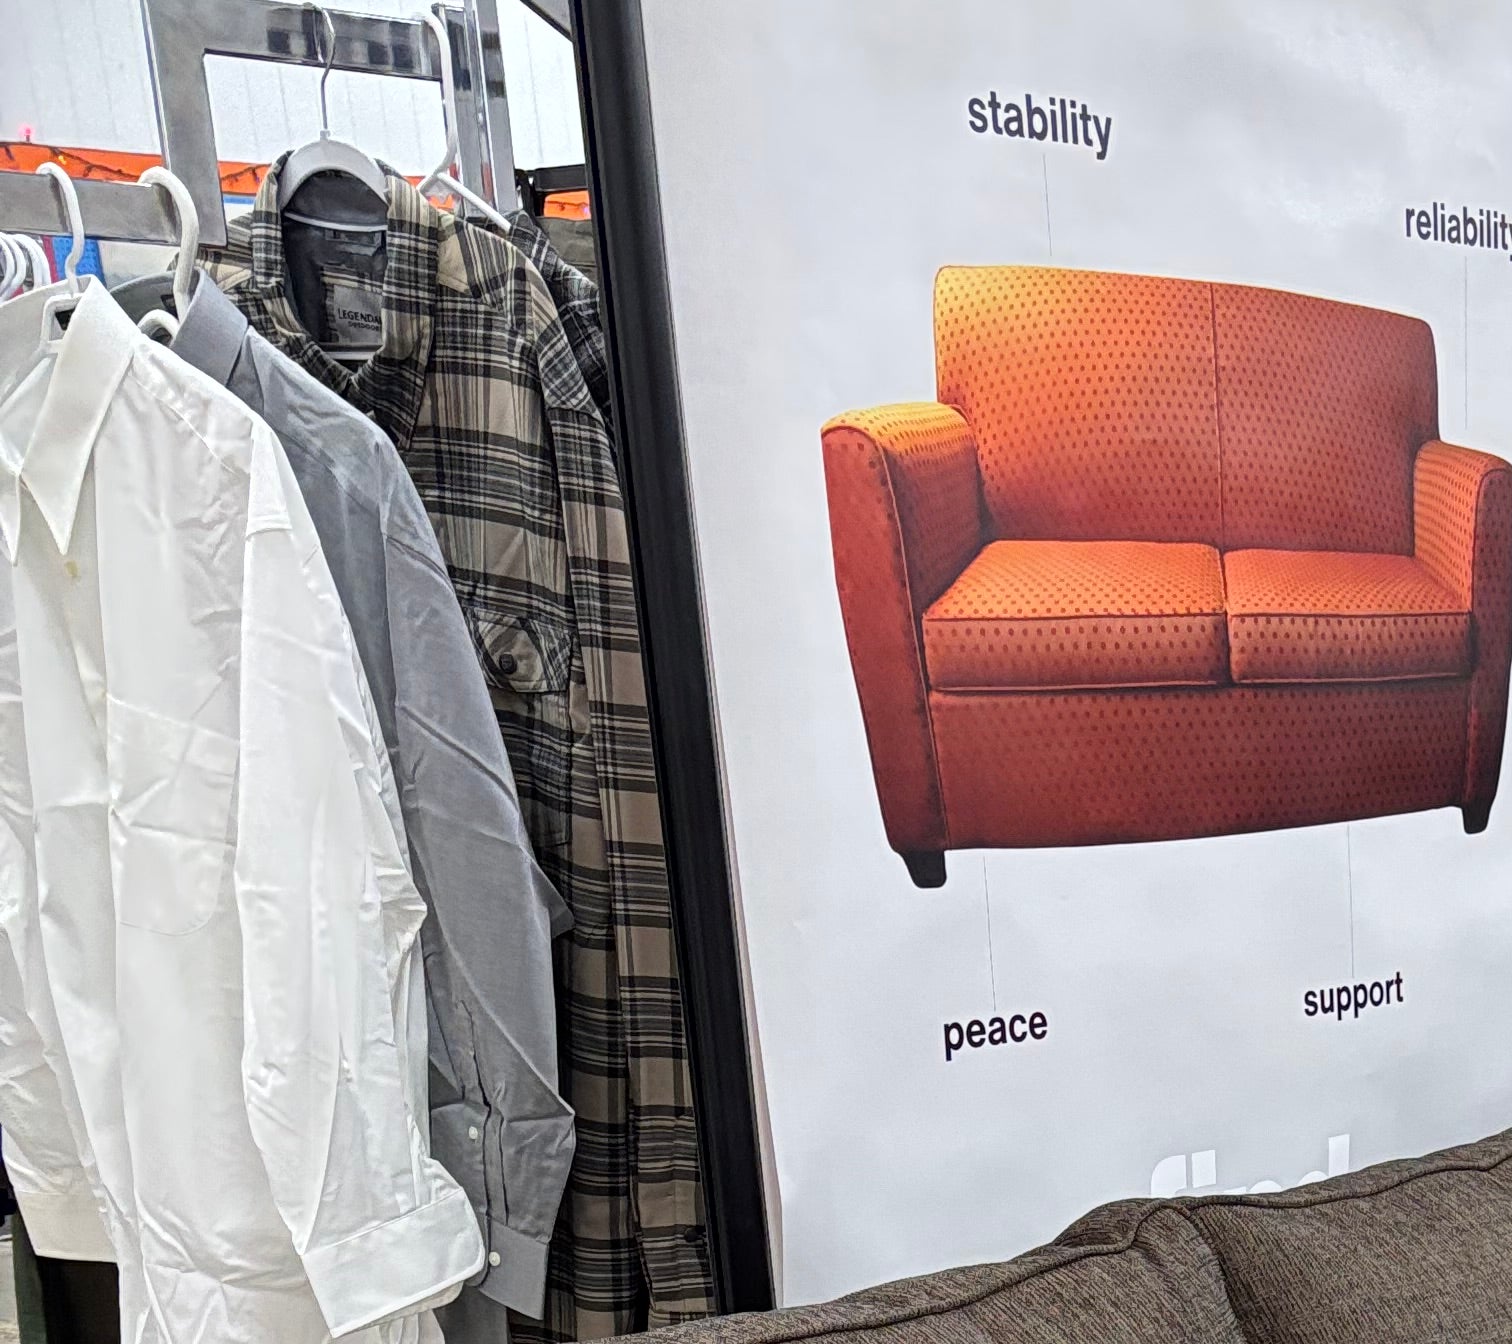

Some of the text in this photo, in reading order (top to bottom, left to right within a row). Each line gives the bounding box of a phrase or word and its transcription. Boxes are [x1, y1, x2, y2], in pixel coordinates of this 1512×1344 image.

[968, 91, 1112, 160] stability
[1304, 971, 1404, 1021] support
[943, 1011, 1048, 1062] peace
